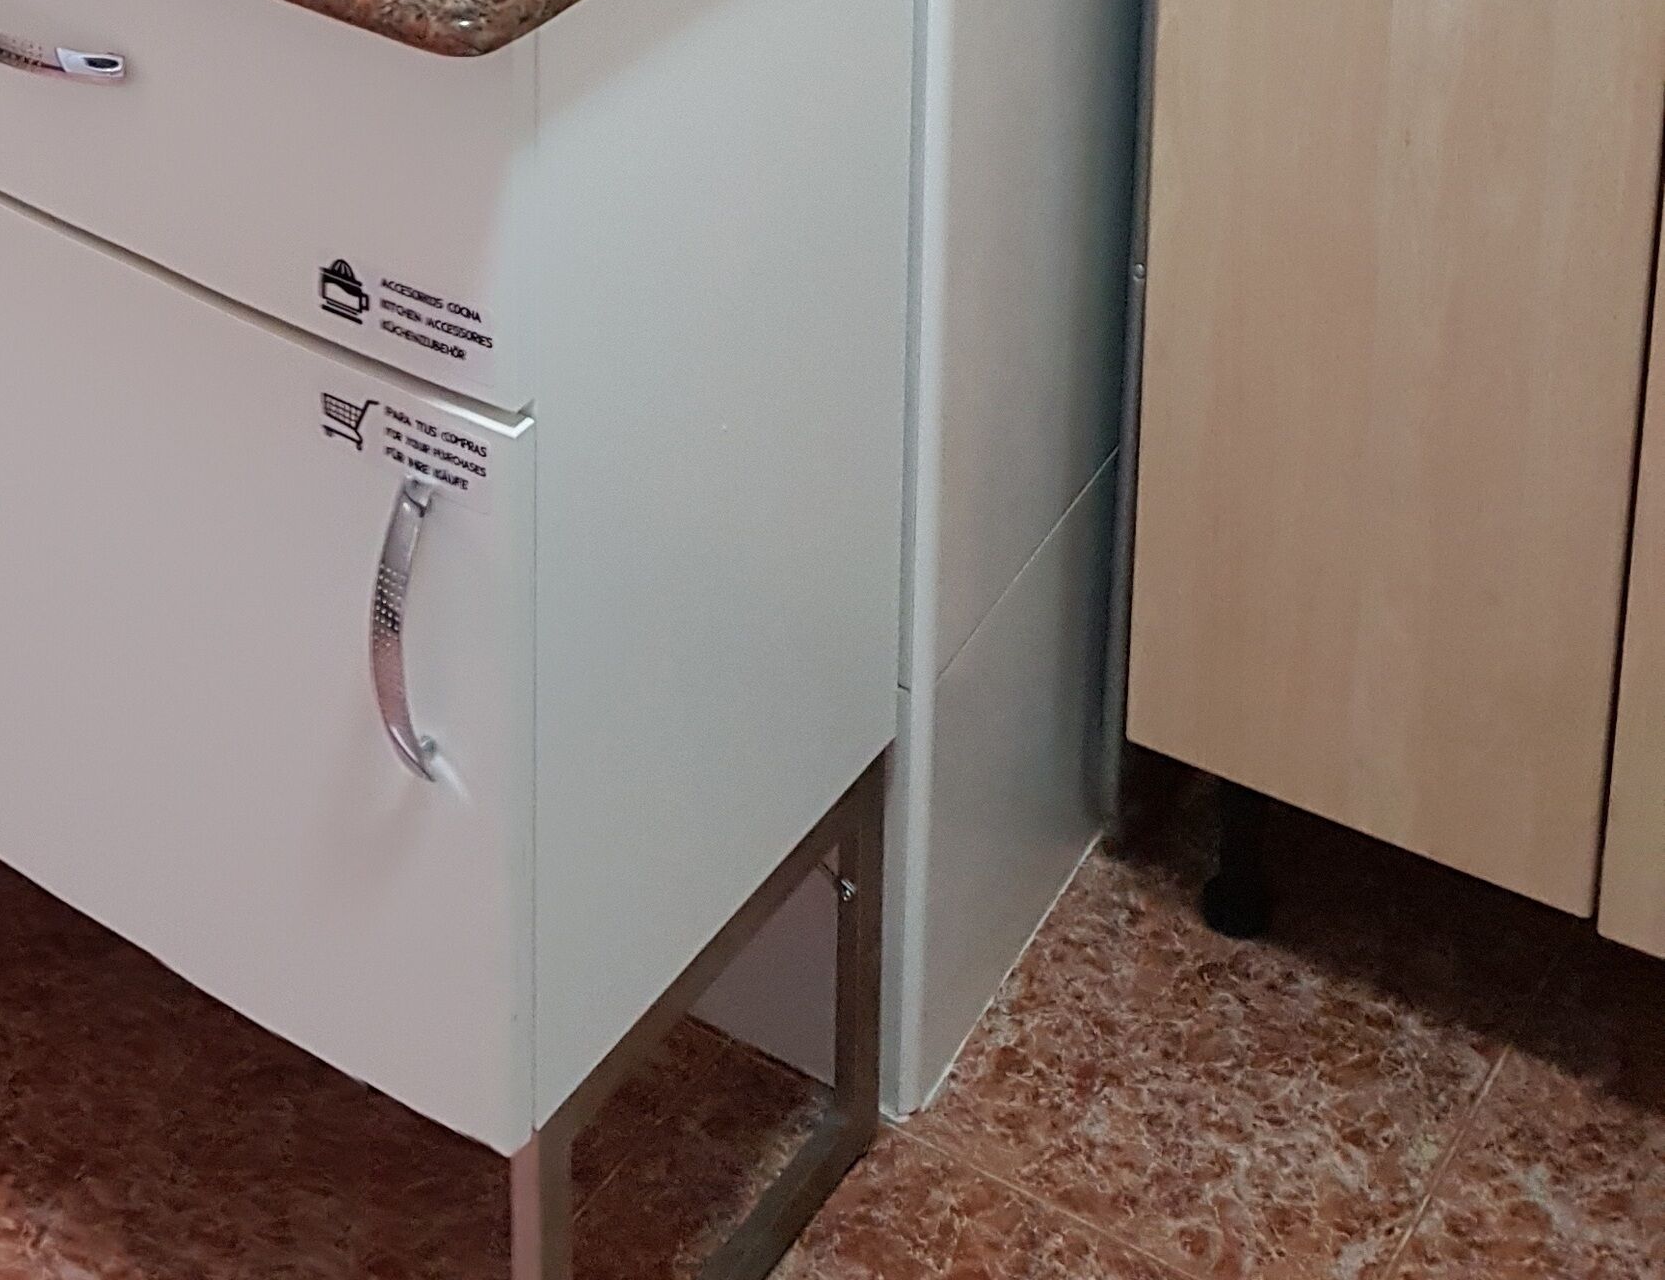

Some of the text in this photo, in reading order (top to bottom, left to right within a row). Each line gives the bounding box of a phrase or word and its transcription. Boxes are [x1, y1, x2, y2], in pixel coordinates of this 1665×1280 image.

[381, 299, 422, 322] KITCHEN
[447, 302, 482, 323] COCINA
[385, 406, 487, 457] PARA TUS COMPRAS
[385, 427, 486, 477] FOR YOUR PURCHASES
